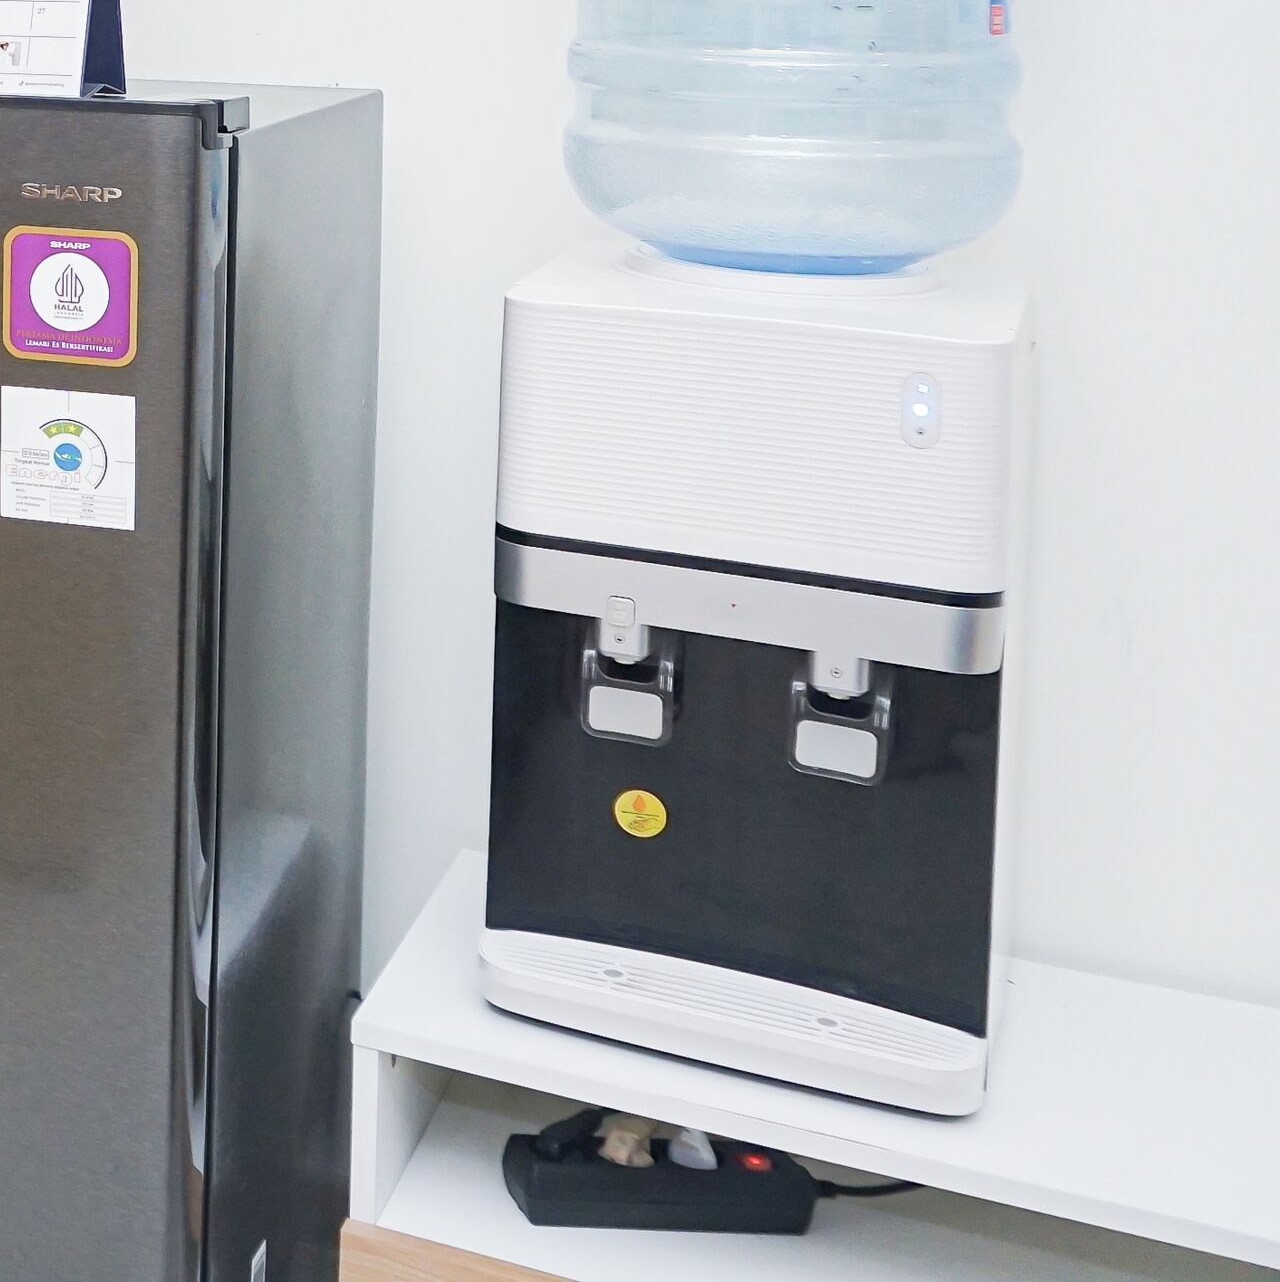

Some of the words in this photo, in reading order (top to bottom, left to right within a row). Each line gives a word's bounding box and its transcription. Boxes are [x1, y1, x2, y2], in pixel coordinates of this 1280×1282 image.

[37, 7, 46, 15] 27
[21, 182, 123, 204] SHARP
[49, 240, 91, 250] SHARP
[54, 303, 84, 312] HALAL
[5, 464, 81, 486] Energi
